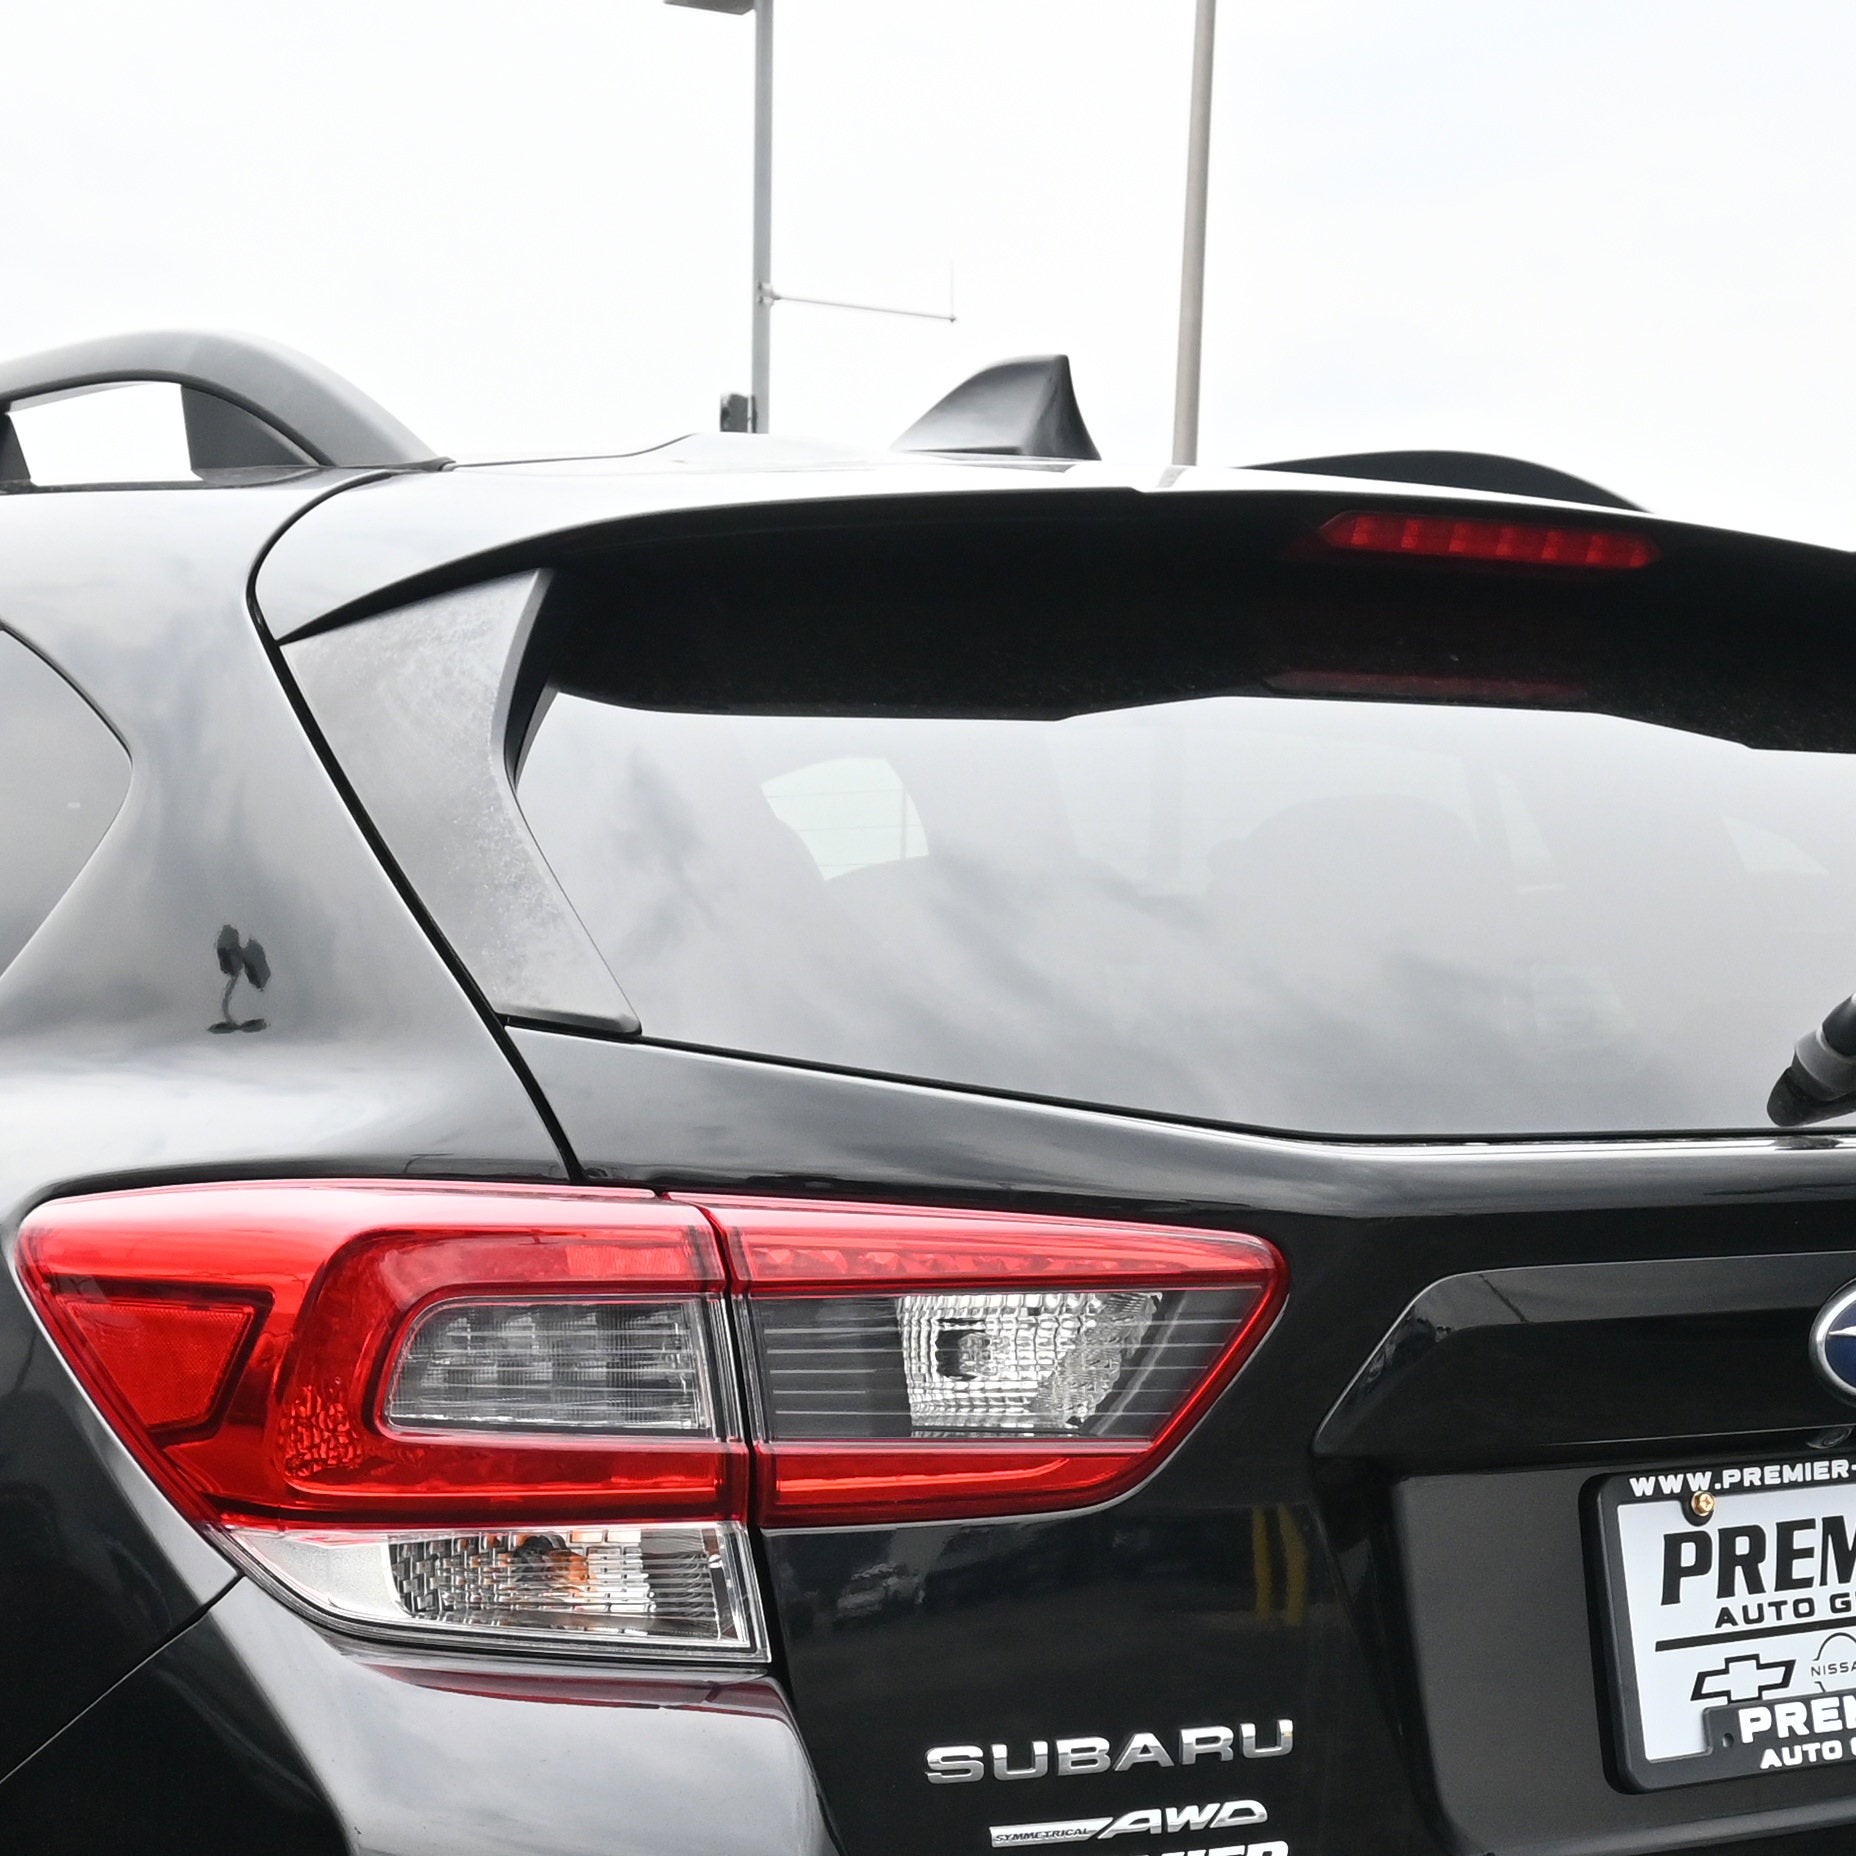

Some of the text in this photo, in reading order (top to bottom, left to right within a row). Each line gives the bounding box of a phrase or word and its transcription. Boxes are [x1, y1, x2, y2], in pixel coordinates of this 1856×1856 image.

[1714, 1599, 1817, 1629] AUTO
[924, 1718, 1295, 1784] SUBARU
[1760, 1741, 1843, 1770] AUTO
[993, 1799, 1270, 1843] SYMMETRICAL AWD
